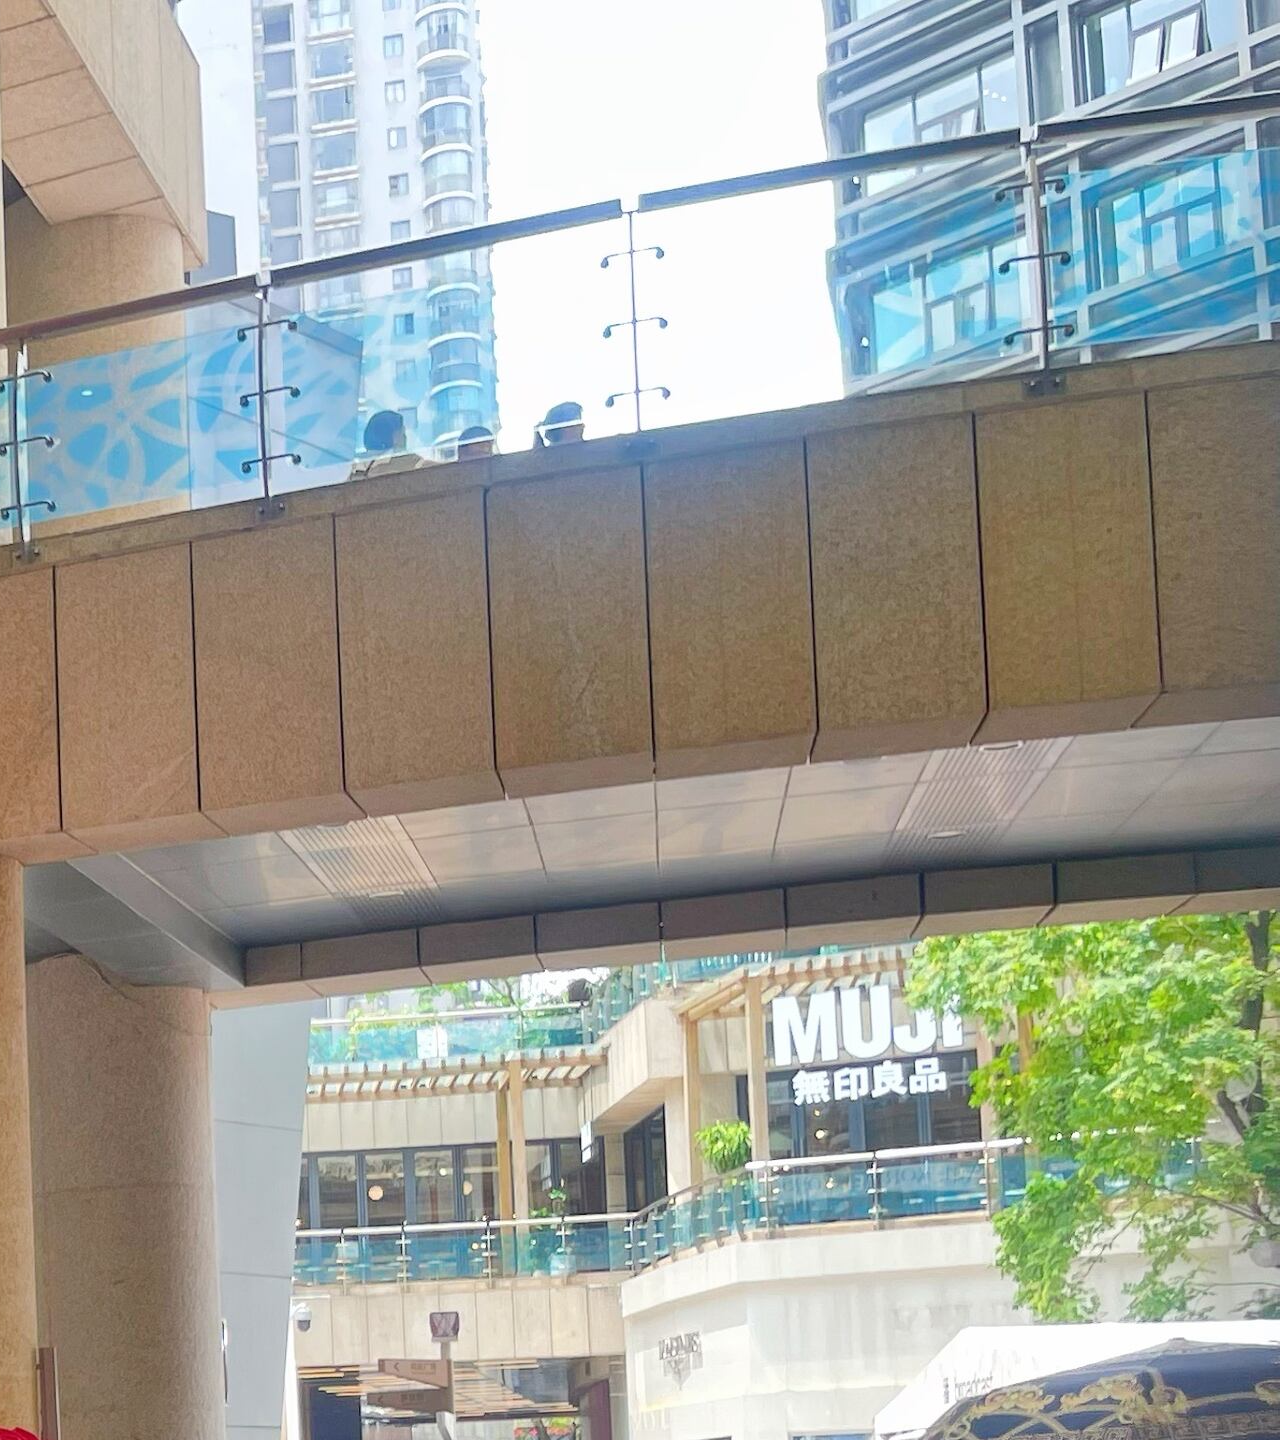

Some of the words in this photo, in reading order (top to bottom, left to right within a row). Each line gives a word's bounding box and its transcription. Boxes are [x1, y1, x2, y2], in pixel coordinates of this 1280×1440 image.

[772, 984, 964, 1067] MUJI
[792, 1057, 948, 1106] 無印良品
